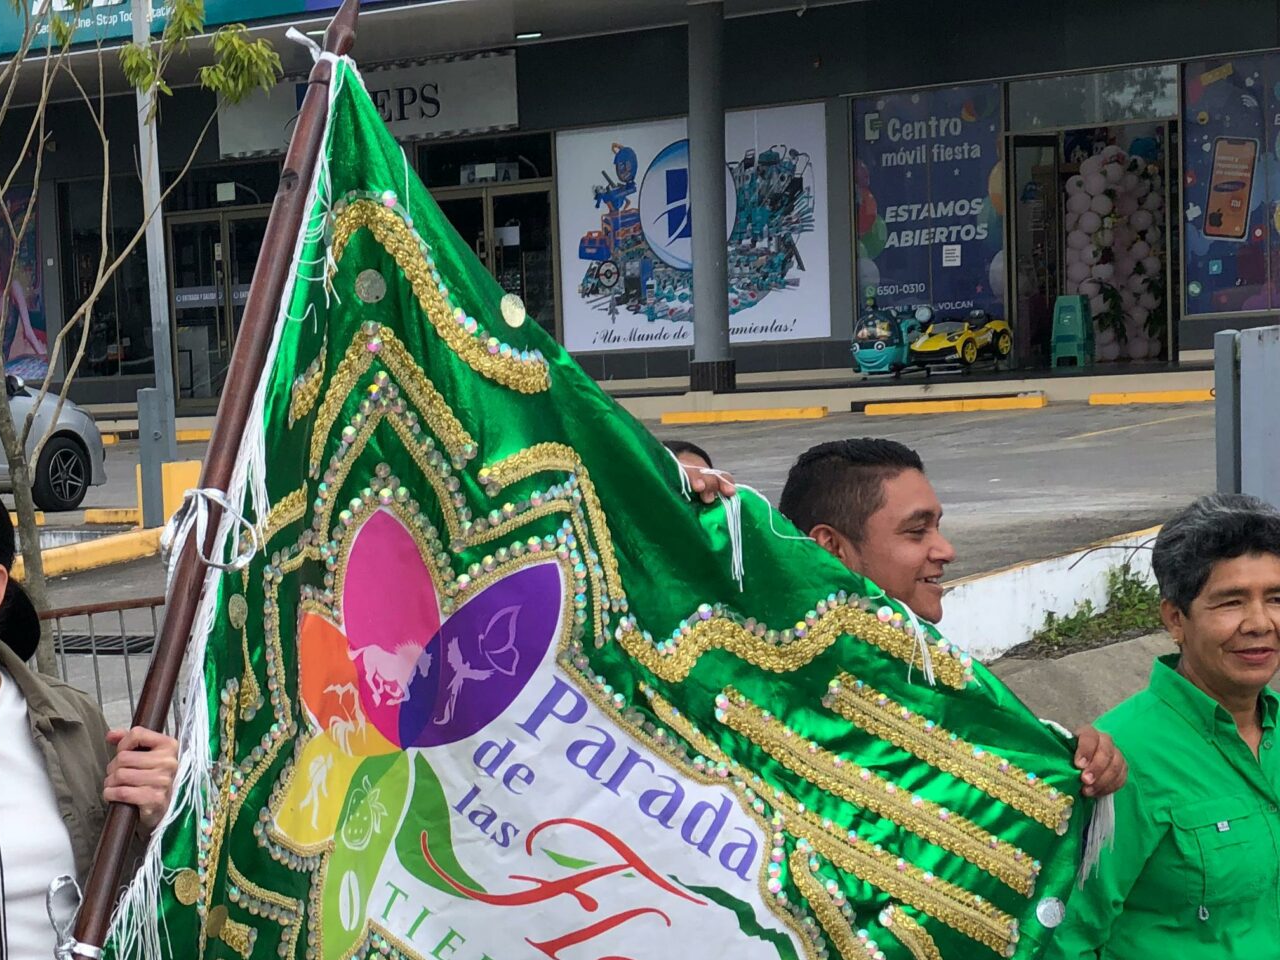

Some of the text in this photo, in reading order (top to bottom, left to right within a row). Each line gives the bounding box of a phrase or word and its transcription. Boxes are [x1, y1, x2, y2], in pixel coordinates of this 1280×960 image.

[371, 83, 441, 123] EPS
[887, 116, 962, 142] Centro
[882, 142, 981, 167] móvil fiesta
[885, 198, 983, 223] ESTAMOS
[884, 223, 988, 248] ABIERTOS
[623, 327, 670, 342] Mundo
[673, 325, 689, 340] de
[728, 319, 797, 336] amientas!
[472, 737, 535, 795] de
[515, 675, 759, 882] Parada
[450, 781, 521, 848] las
